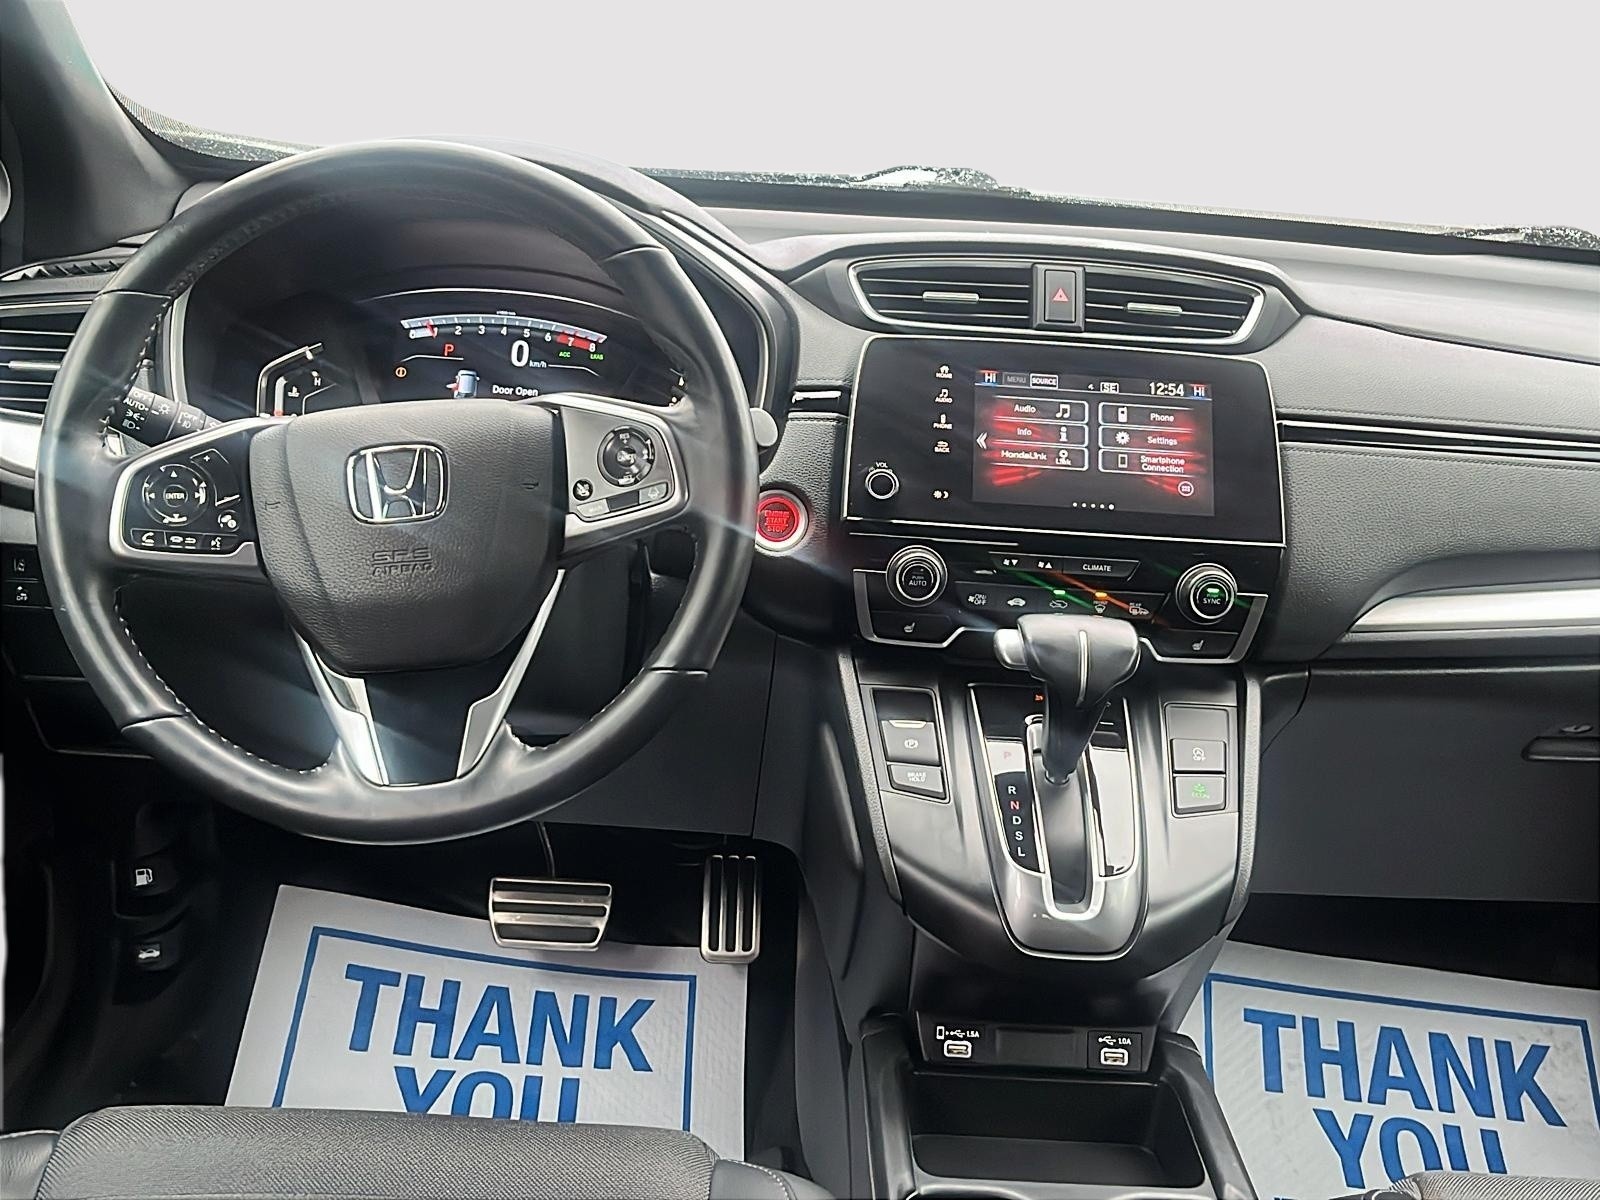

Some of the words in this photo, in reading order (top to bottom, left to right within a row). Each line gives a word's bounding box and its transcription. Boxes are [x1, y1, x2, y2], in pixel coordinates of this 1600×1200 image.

[455, 326, 462, 336] 2
[478, 325, 485, 335] 3
[501, 327, 507, 336] 4
[523, 329, 530, 338] 5
[545, 333, 552, 341] 6
[568, 337, 574, 346] 7
[589, 343, 596, 352] 8
[444, 344, 454, 356] P
[511, 340, 529, 367] 0
[529, 360, 547, 368] km/h
[985, 372, 996, 383] Hi
[1031, 376, 1057, 387] SOURCE
[492, 385, 513, 394] Door
[515, 386, 538, 397] Open
[1149, 382, 1185, 397] 12:54
[1193, 386, 1205, 397] Hi
[1014, 404, 1036, 414] Audio
[1150, 413, 1175, 423] Phone
[1017, 427, 1032, 436] Info
[1147, 436, 1178, 447] Settings
[1001, 450, 1047, 461] HondaLink
[1140, 455, 1185, 467] Smartphone
[1141, 463, 1184, 474] Connection
[1082, 563, 1112, 572] CLIMATE
[1008, 786, 1016, 795] R
[1010, 801, 1020, 809] N
[1012, 816, 1022, 825] D
[1015, 831, 1023, 841] S
[1017, 847, 1025, 857] L
[345, 963, 655, 1073] THANK
[1243, 1008, 1568, 1127] THANK
[1312, 1108, 1507, 1190] YOU
